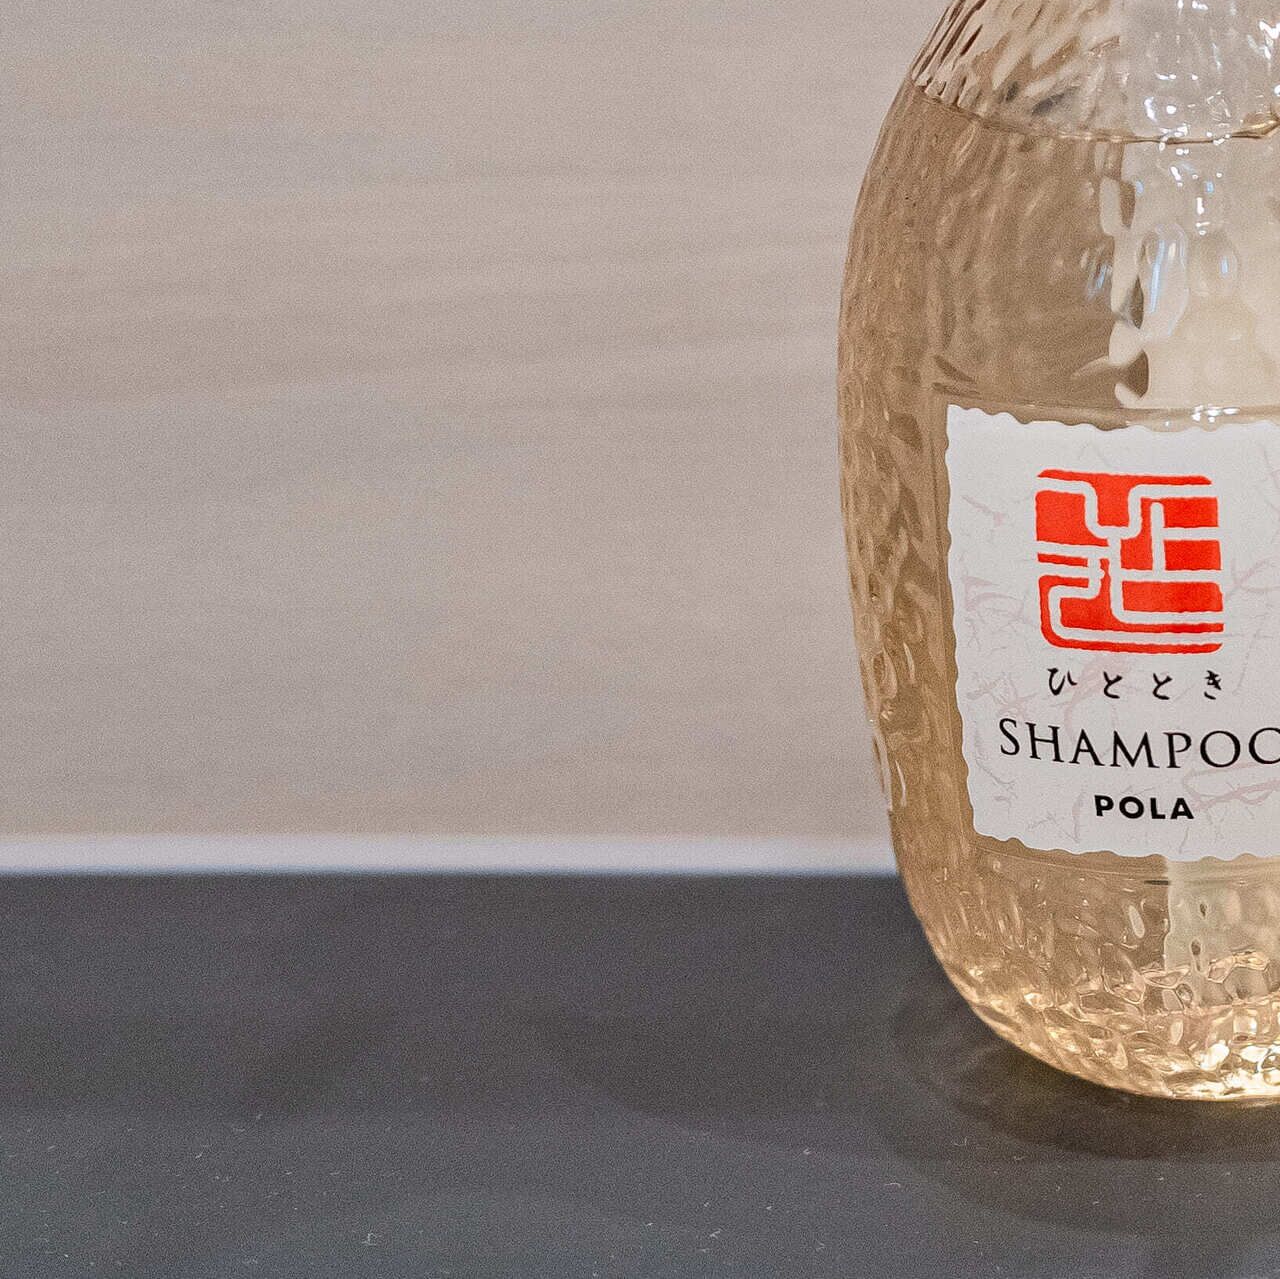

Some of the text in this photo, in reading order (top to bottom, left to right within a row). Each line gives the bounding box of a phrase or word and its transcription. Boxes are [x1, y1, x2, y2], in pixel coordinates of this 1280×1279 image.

[1047, 667, 1223, 701] ひととき
[1094, 794, 1195, 820] POLA
